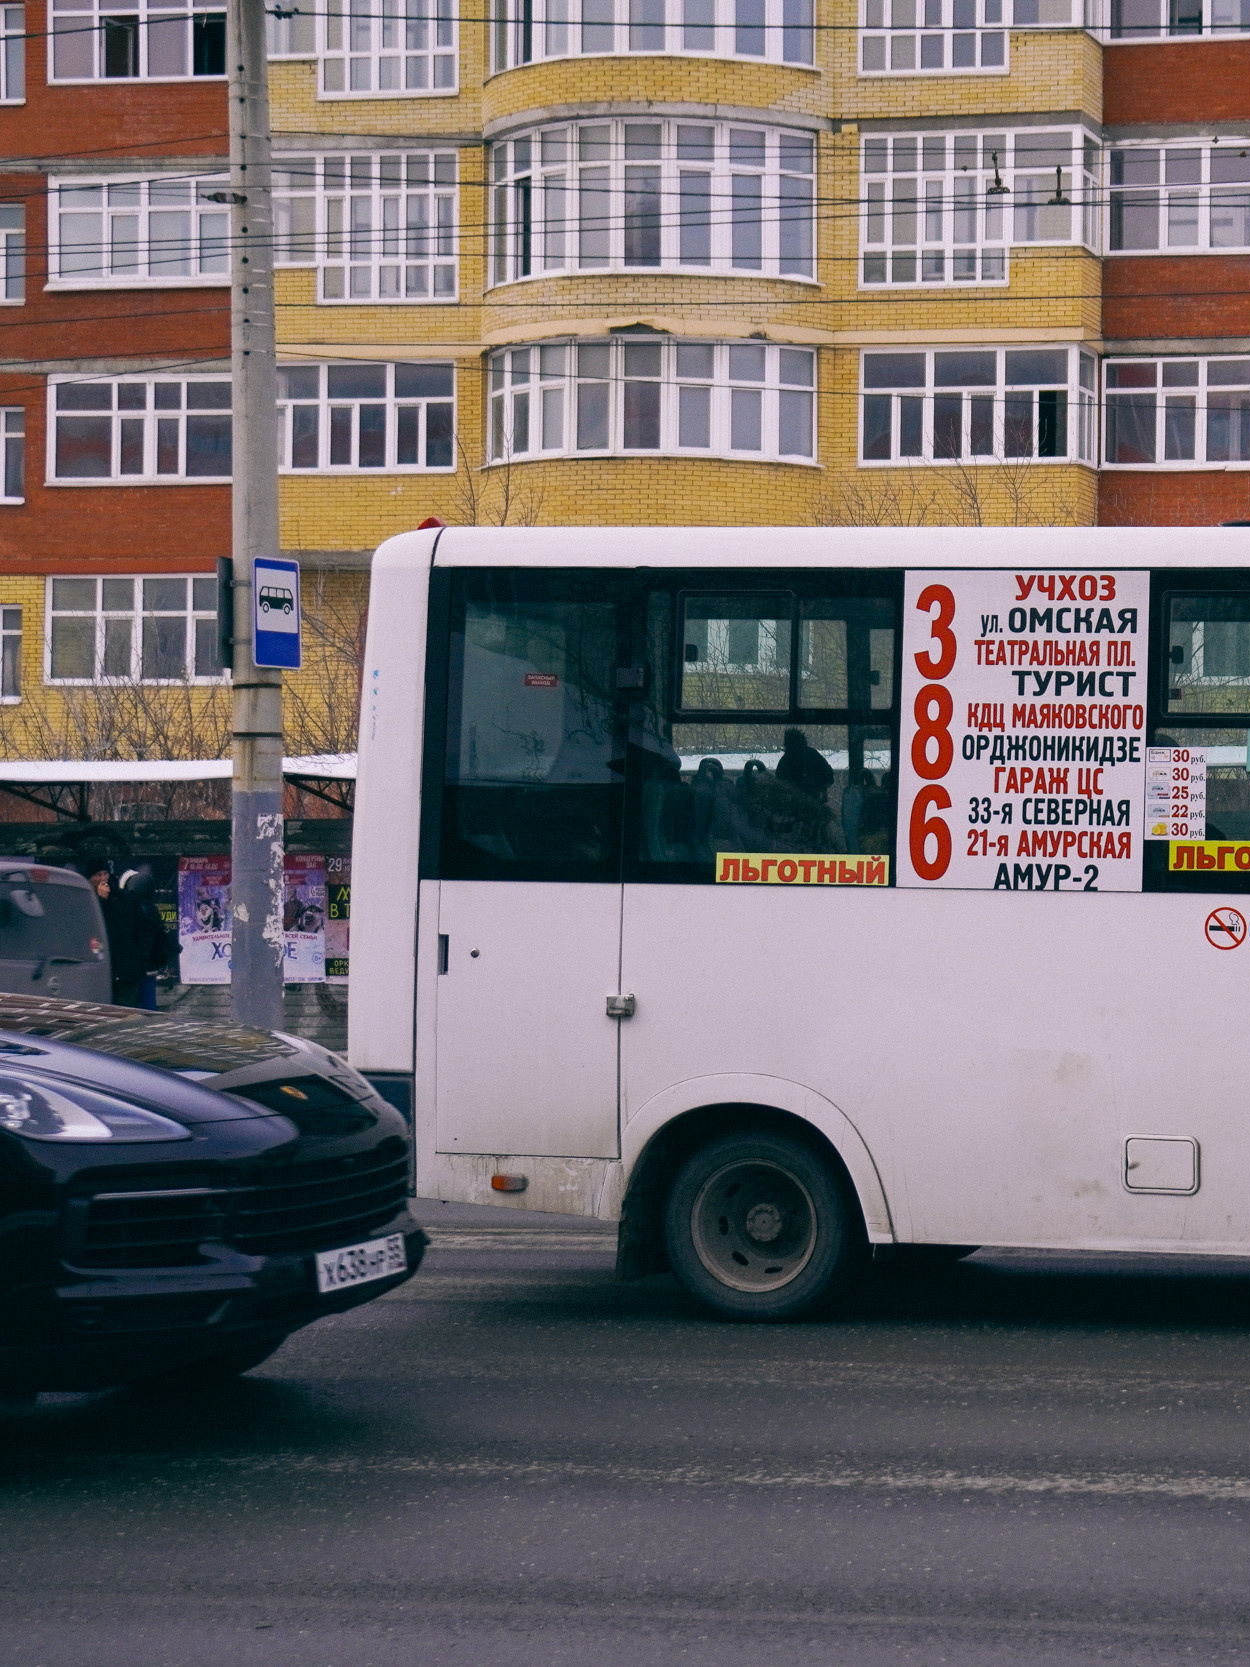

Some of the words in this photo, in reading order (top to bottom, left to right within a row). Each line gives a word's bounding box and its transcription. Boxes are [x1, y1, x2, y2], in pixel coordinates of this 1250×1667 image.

[1015, 574, 1116, 601] УЧХОЗ
[980, 613, 1003, 637] ул.
[1008, 607, 1138, 634] ОМСКАЯ
[974, 639, 1100, 666] ТЕАТРАЛЬНАЯ
[1106, 640, 1136, 666] ПЛ.
[1011, 671, 1137, 697] ТУРИСТ
[967, 703, 1005, 732] КДЦ
[1012, 703, 1144, 729] МАЯКОВСКОГО
[962, 734, 1142, 767] ОРДЖОНИКИДЗЕ
[1172, 749, 1190, 763] 30
[1190, 755, 1206, 766] руб.
[994, 767, 1069, 795] ГАРАЖ
[1077, 768, 1104, 800] ЦС
[1172, 767, 1190, 781] 30
[1190, 773, 1206, 784] руб.
[1171, 786, 1189, 800] 25
[1190, 792, 1206, 802] руб.
[968, 797, 1013, 825] 33-я
[1021, 799, 1130, 826] СЕВЕРНАЯ
[1171, 804, 1188, 818] 22
[1190, 810, 1205, 820] руб.
[967, 829, 1009, 857] 21-я
[1017, 830, 1131, 859] АМУРСКАЯ
[1171, 823, 1188, 836] 30
[1189, 829, 1205, 839] руб.
[328, 858, 343, 872] 29
[720, 855, 885, 884] ЛЬГОТНЫЙ
[993, 863, 1099, 891] АМУР-2
